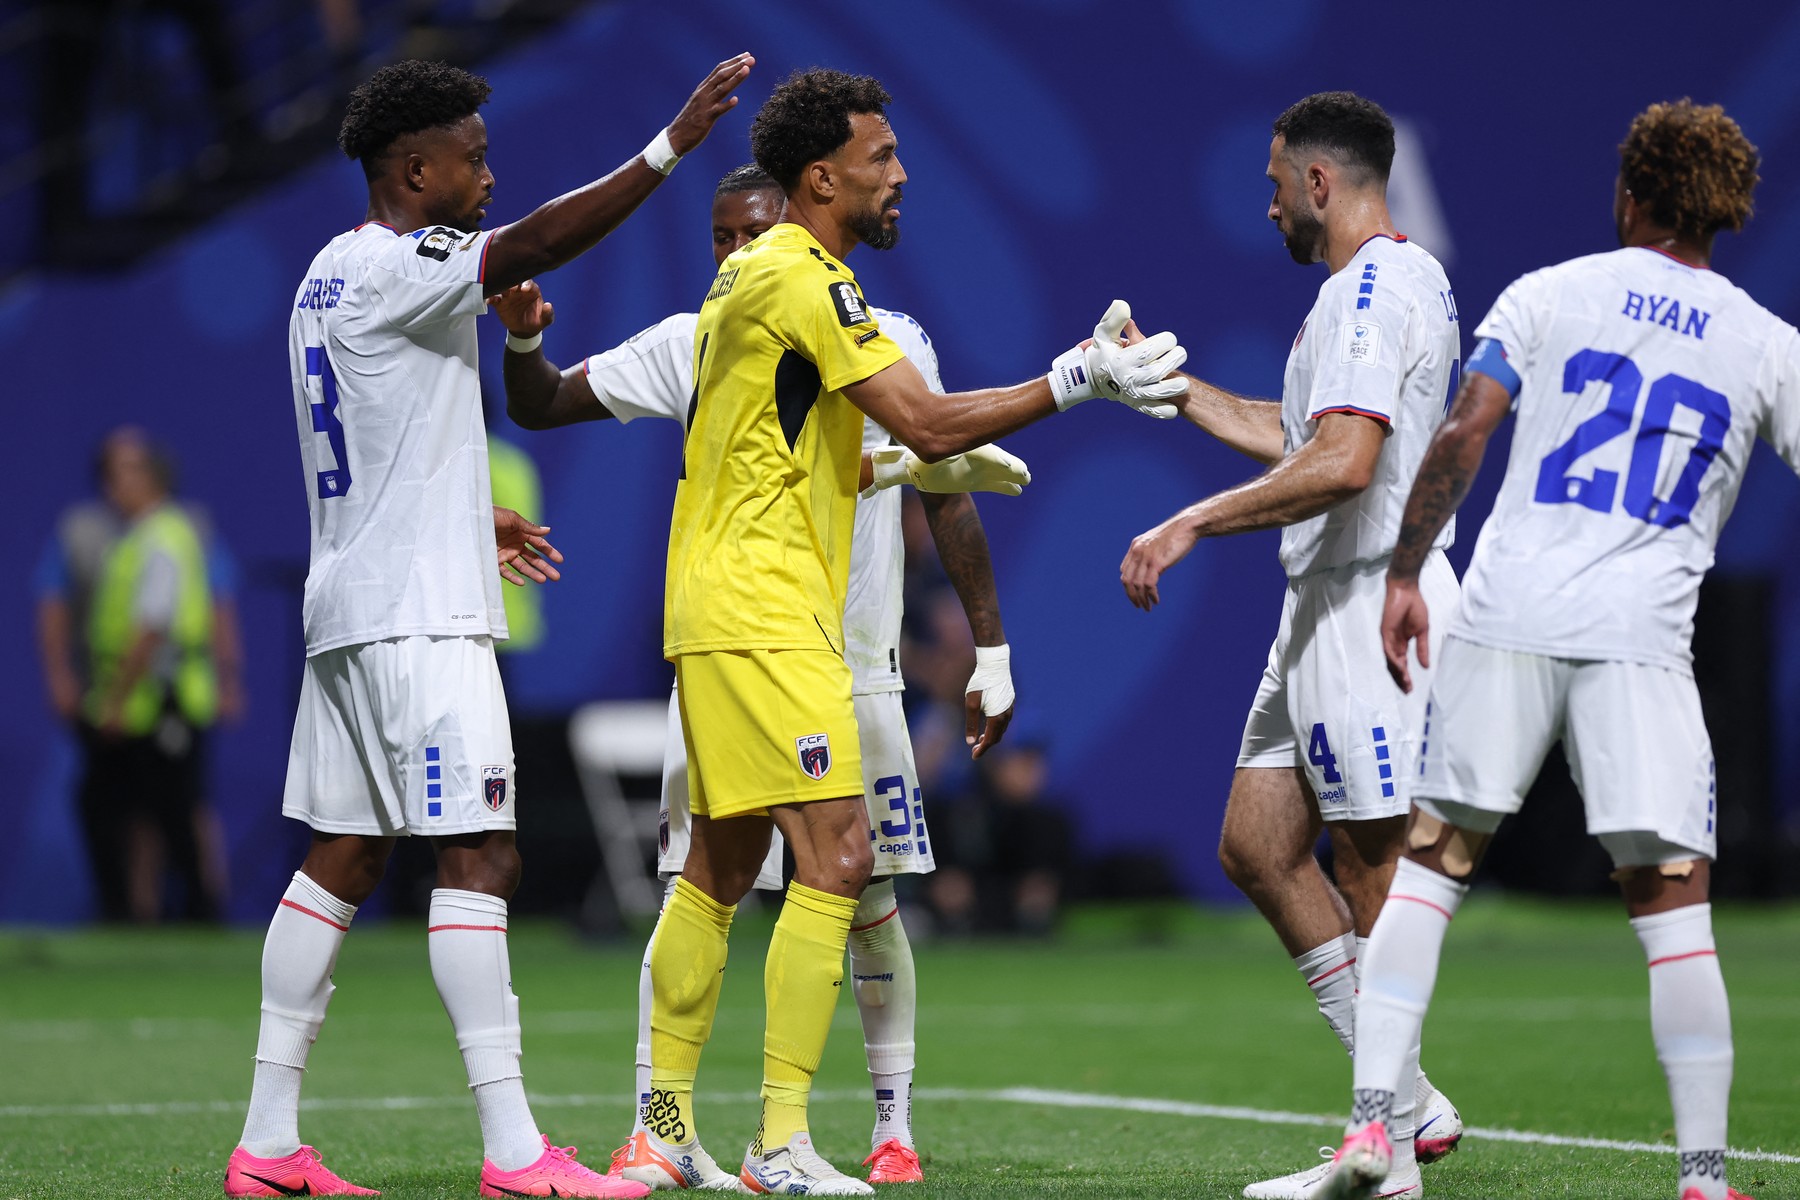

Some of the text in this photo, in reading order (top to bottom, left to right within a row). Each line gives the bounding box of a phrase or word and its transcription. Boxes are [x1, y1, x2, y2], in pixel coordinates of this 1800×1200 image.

[1622, 290, 1710, 339] RYAN
[1060, 365, 1072, 394] VOZINHA
[305, 346, 352, 499] 3
[1534, 348, 1731, 529] 20
[798, 735, 825, 746] FCF
[1308, 722, 1342, 784] 4
[870, 775, 911, 841] 3
[1318, 786, 1346, 802] capelli
[877, 1104, 895, 1112] SLC
[879, 1113, 891, 1121] 55
